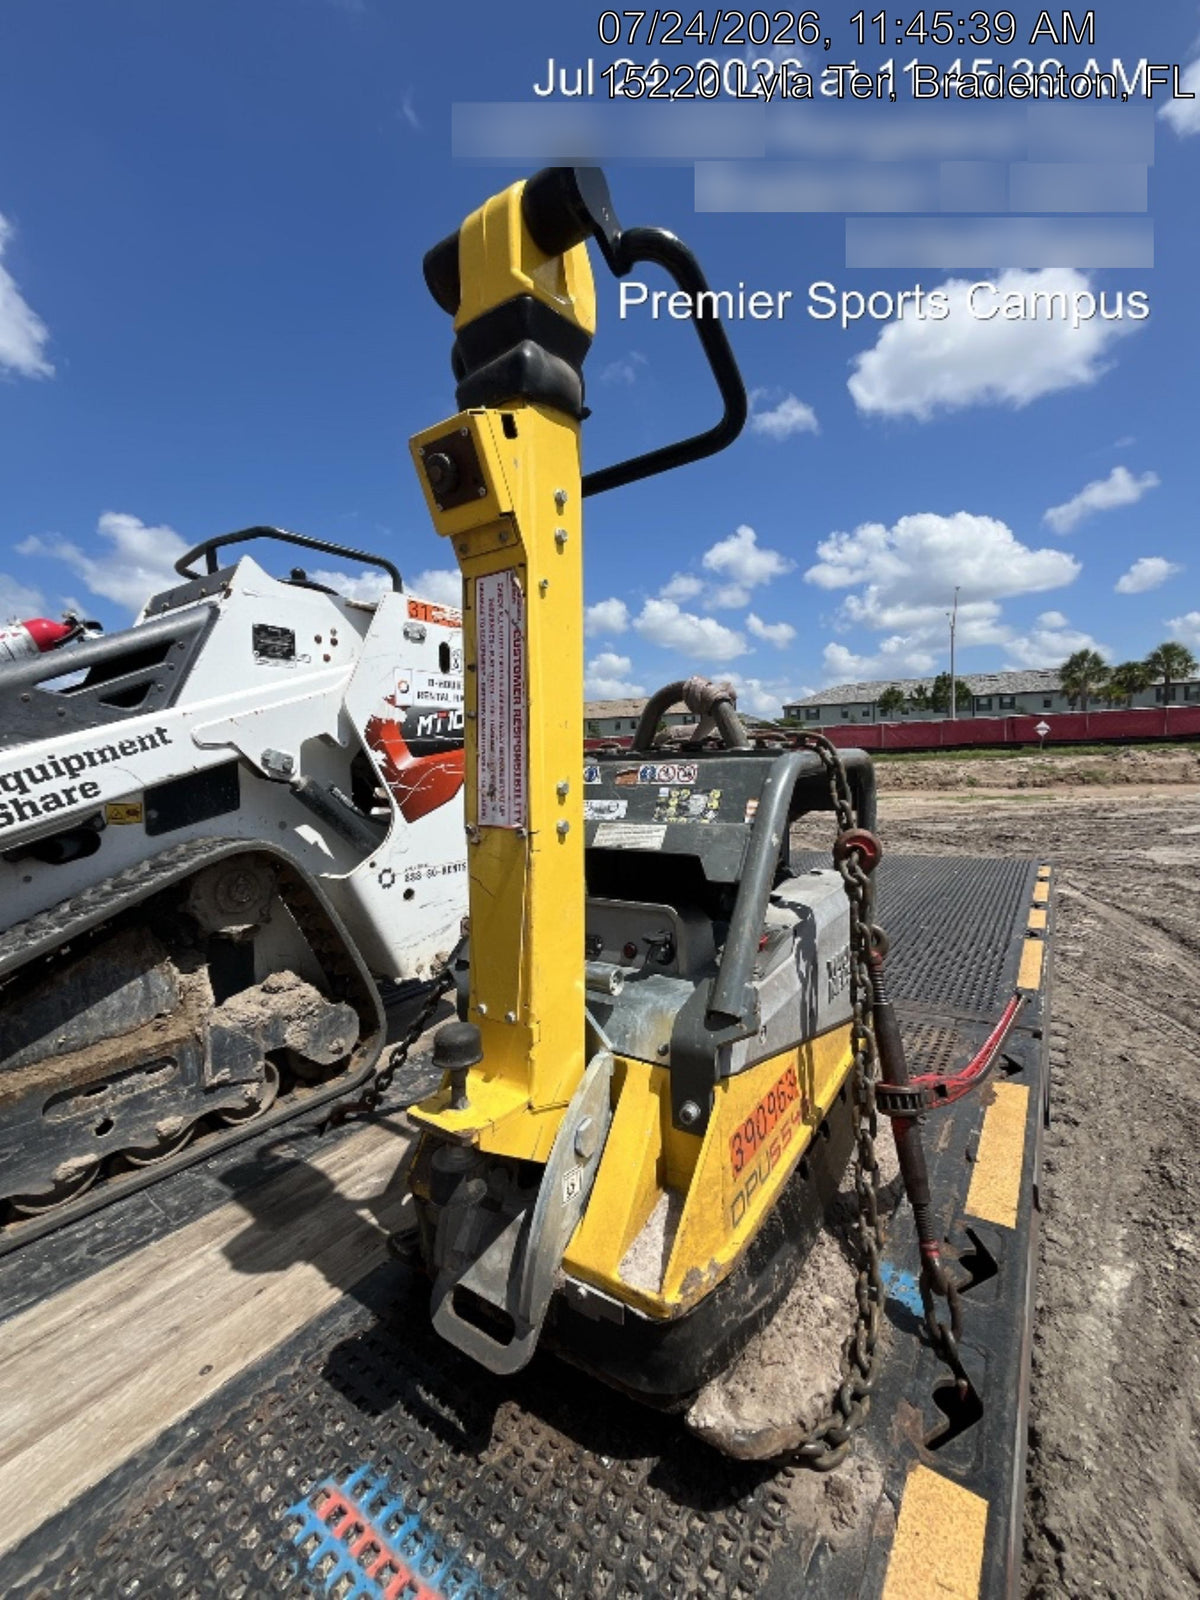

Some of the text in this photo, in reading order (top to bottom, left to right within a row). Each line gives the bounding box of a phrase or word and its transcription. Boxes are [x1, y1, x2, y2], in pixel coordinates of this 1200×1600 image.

[513, 629, 522, 704] CUSTOMER
[0, 727, 173, 795] quipment
[513, 708, 522, 824] RESPONSIBILITY
[731, 1067, 798, 1173] 390963
